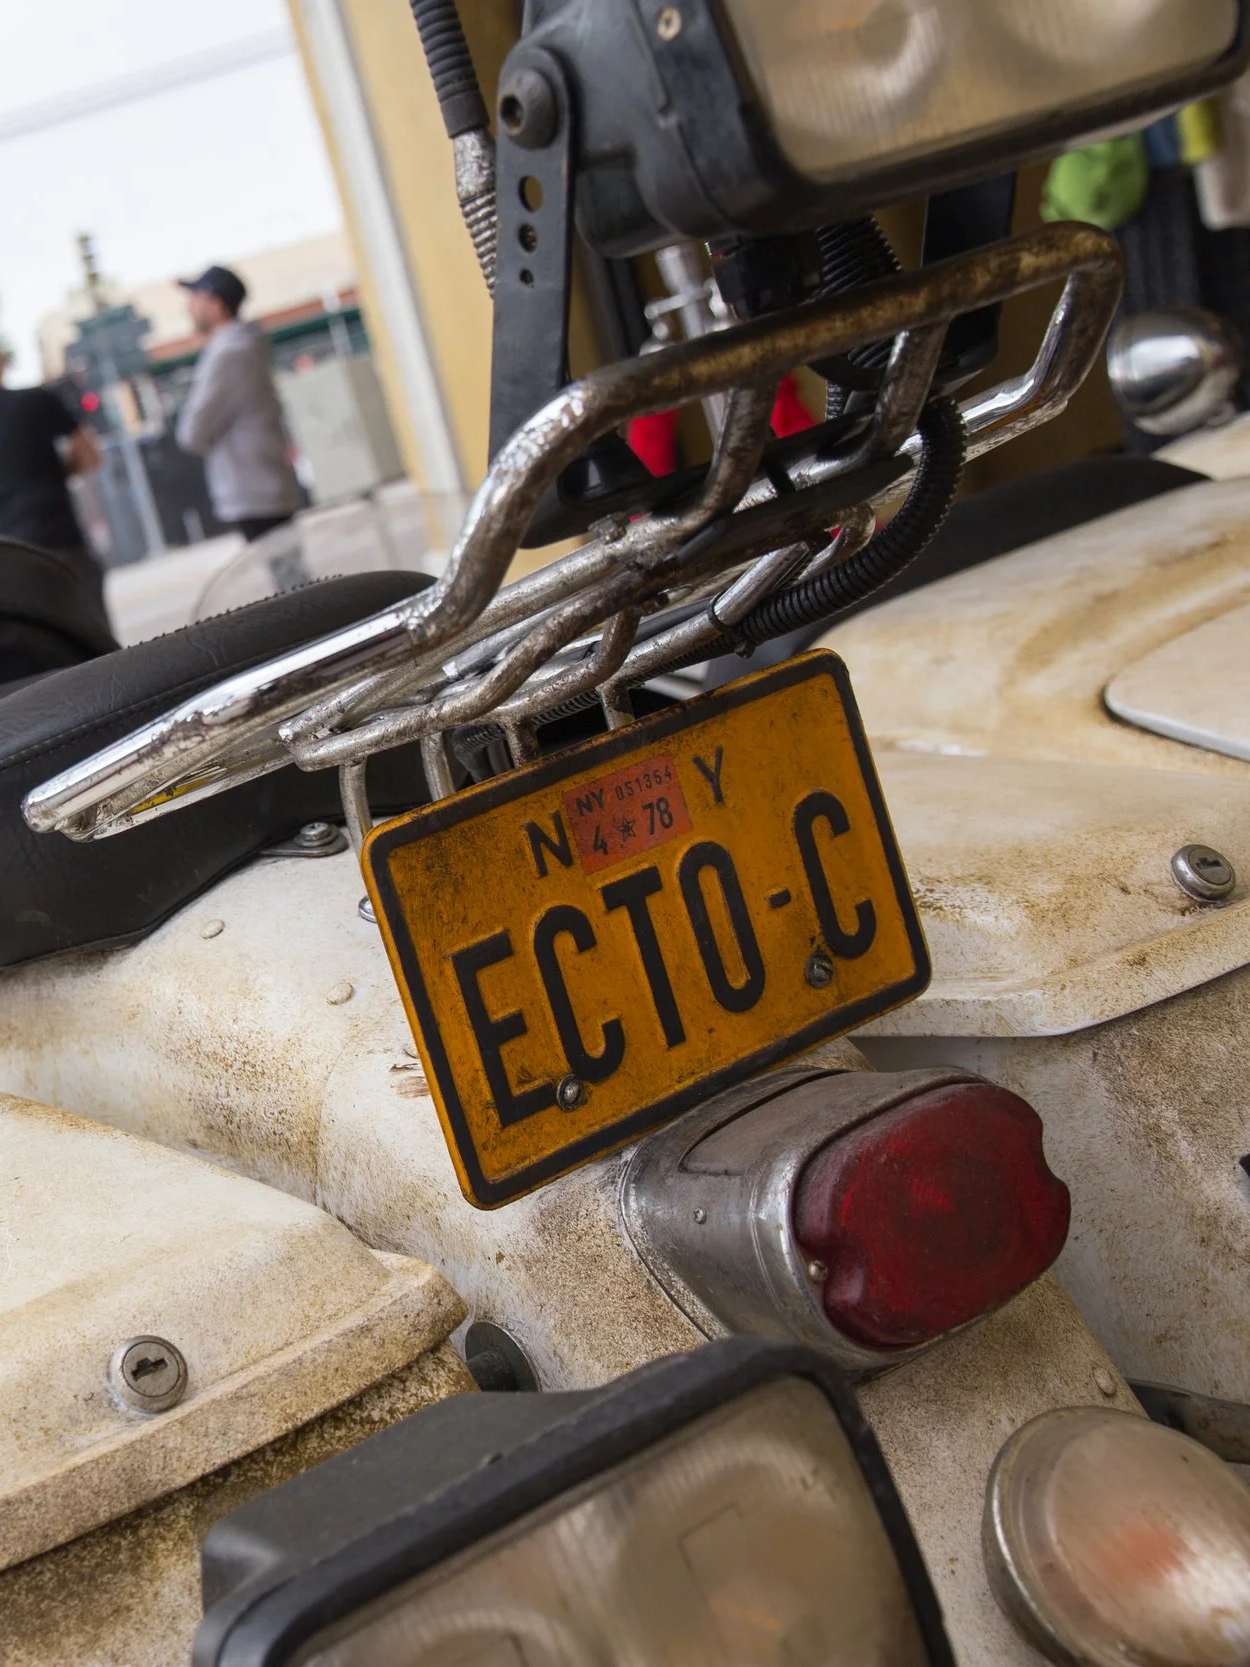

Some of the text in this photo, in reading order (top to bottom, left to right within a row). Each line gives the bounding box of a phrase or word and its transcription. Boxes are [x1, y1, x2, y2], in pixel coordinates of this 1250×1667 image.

[524, 745, 724, 878] N Y
[575, 788, 605, 817] NY
[592, 796, 674, 856] 4 78
[451, 789, 877, 1128] ECTO-C
